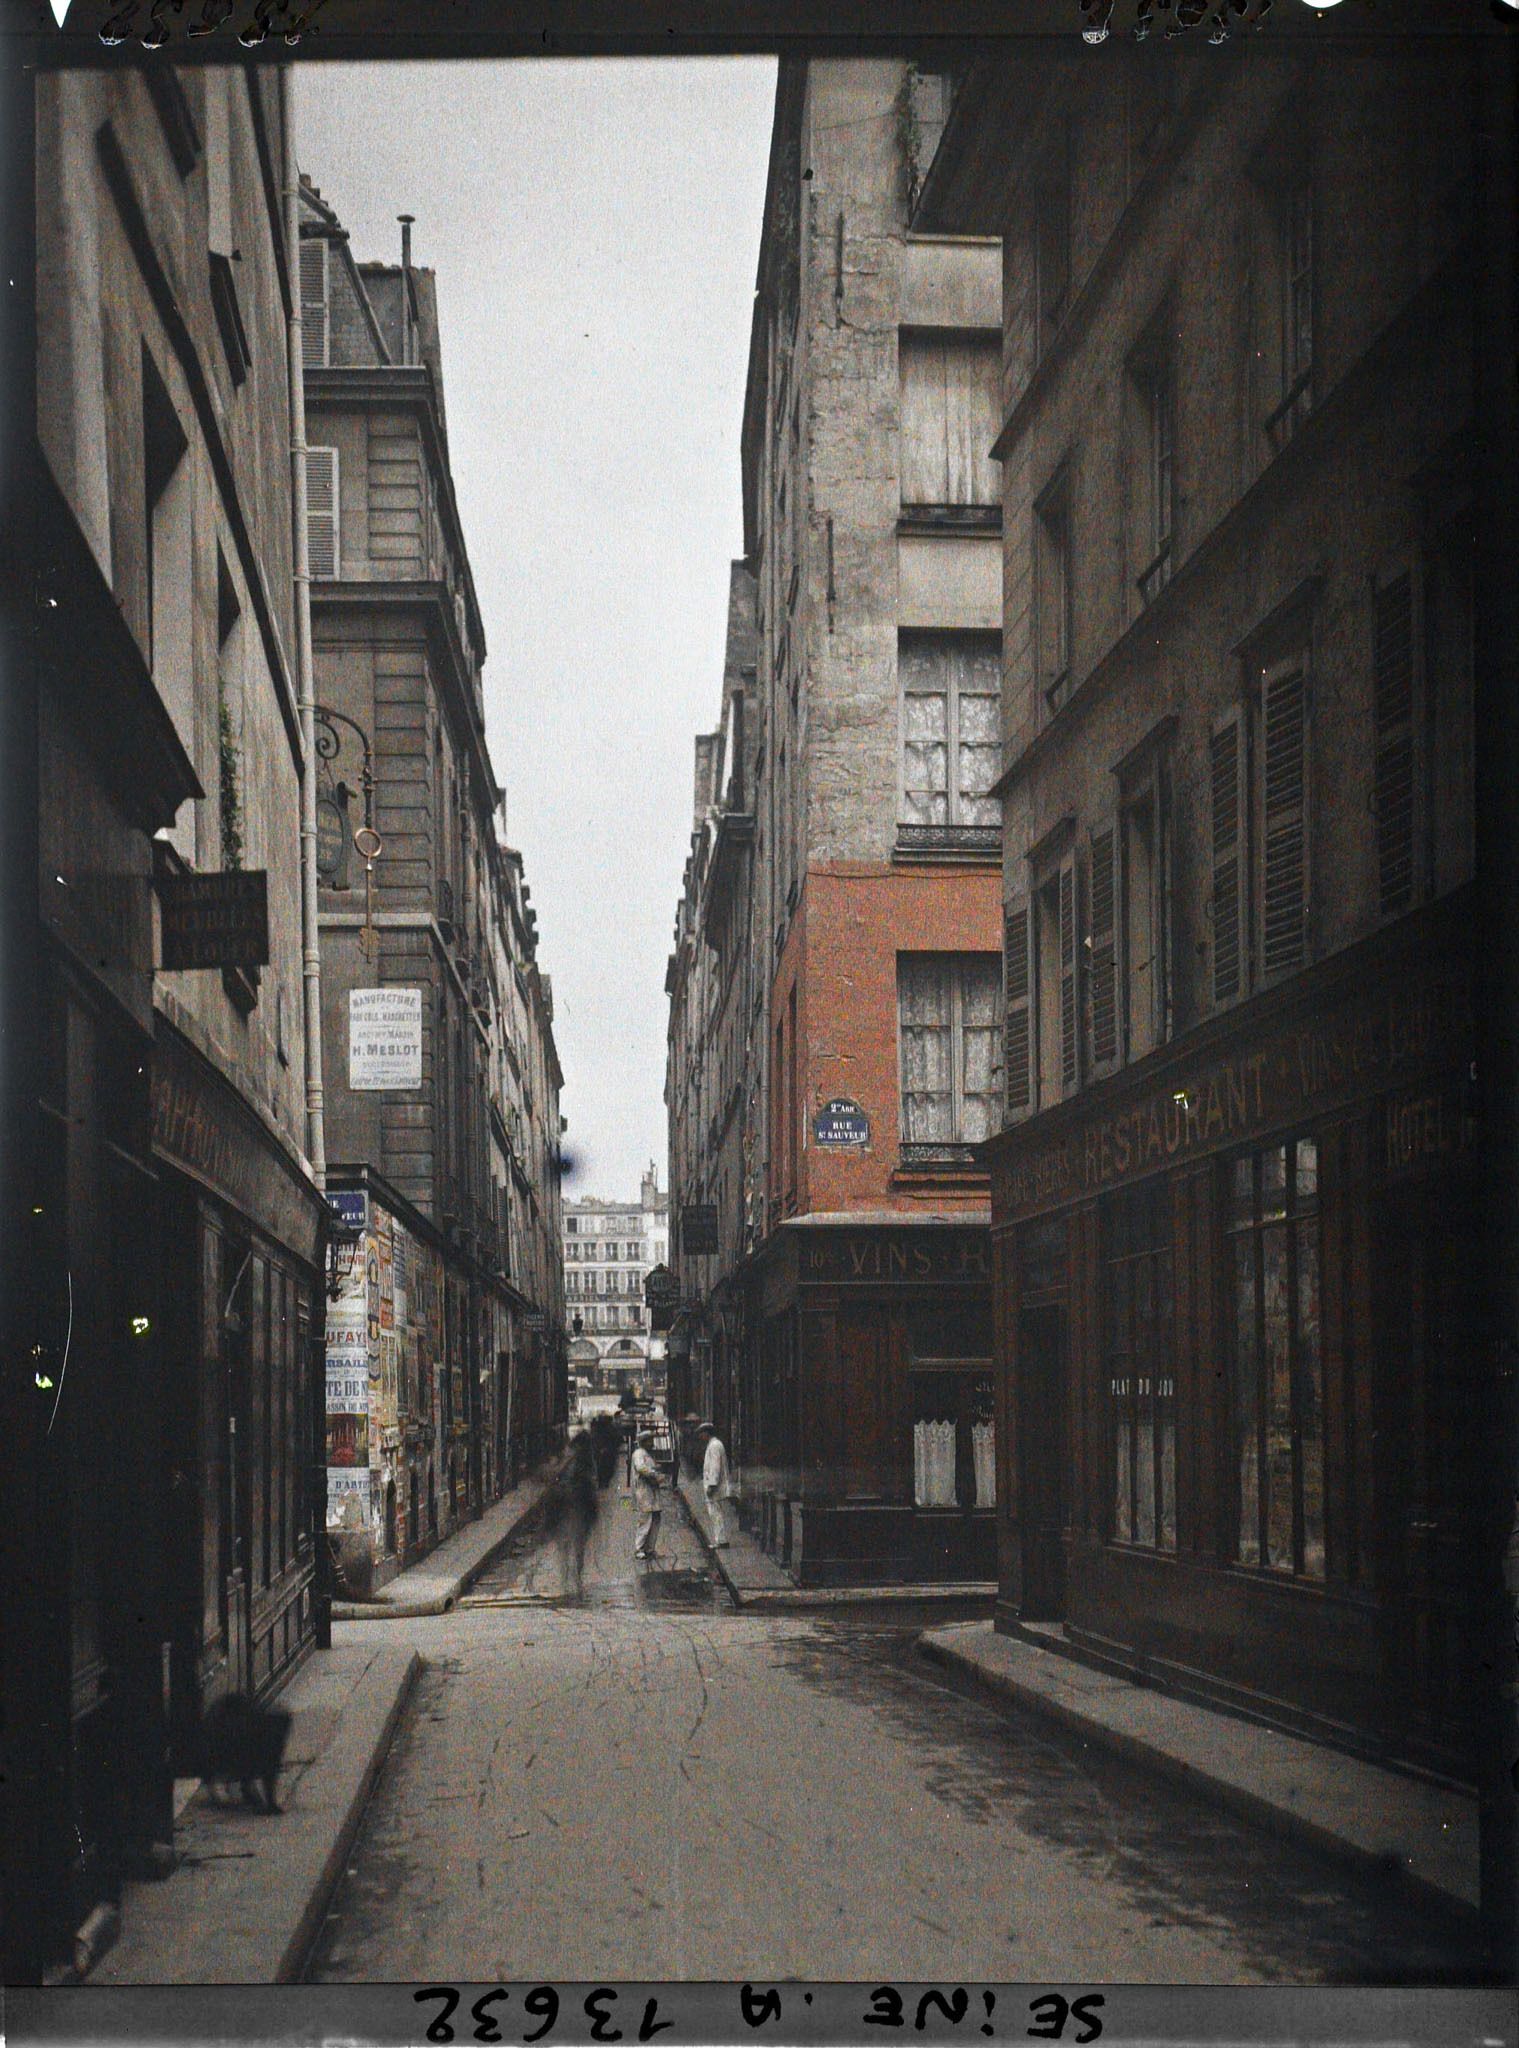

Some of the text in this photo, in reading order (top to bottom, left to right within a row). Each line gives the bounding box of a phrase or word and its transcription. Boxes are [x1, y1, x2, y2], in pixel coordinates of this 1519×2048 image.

[352, 993, 417, 1008] MANUFACTURE
[367, 1044, 419, 1056] MESLOT
[832, 1121, 852, 1130] RUE
[1085, 1053, 1268, 1186] RESTAURANT
[827, 1131, 866, 1140] SAUVEUR
[848, 1239, 932, 1275] VINS
[326, 1380, 342, 1397] TE
[344, 1380, 360, 1397] DE
[412, 1986, 675, 2044] 13632
